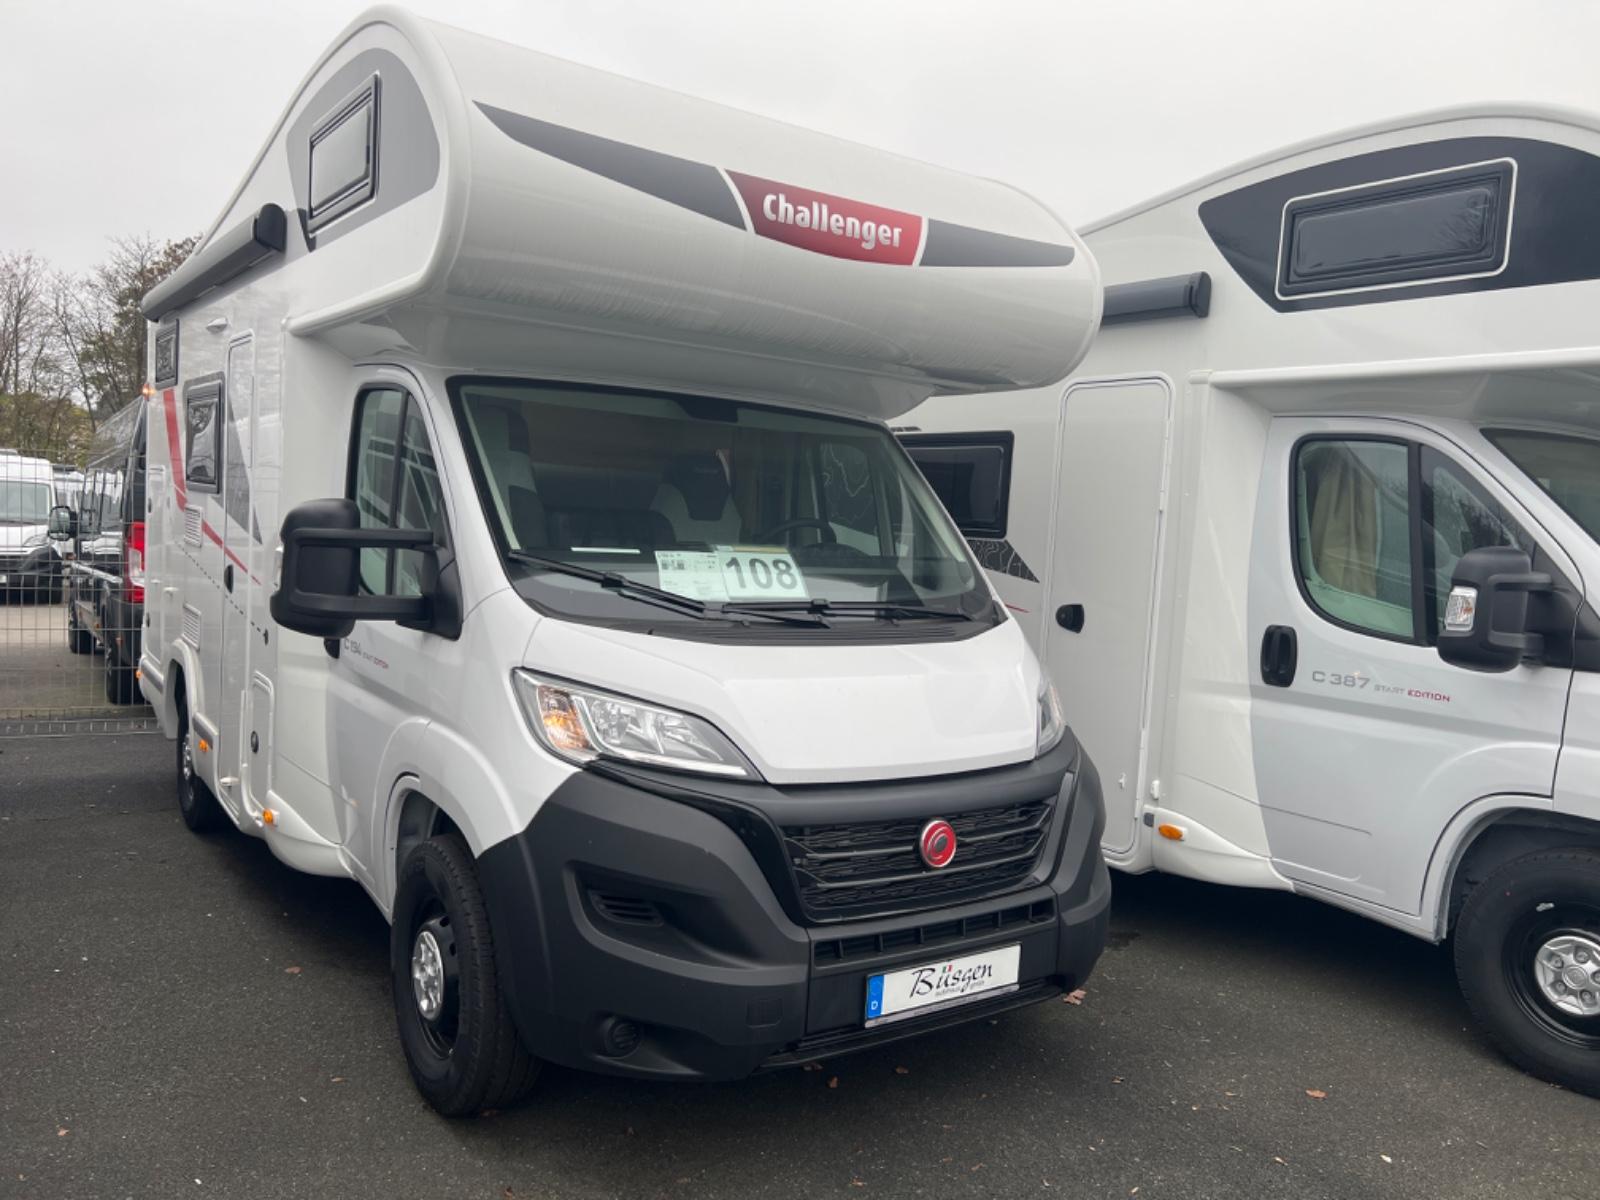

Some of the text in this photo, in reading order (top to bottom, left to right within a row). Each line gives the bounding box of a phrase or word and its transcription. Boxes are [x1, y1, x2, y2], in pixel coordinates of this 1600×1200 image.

[763, 193, 902, 250] Challenger
[726, 557, 798, 590] 108
[1312, 670, 1450, 702] C 387 START EDITION
[909, 963, 993, 999] Büsgen
[871, 1000, 879, 1010] D
